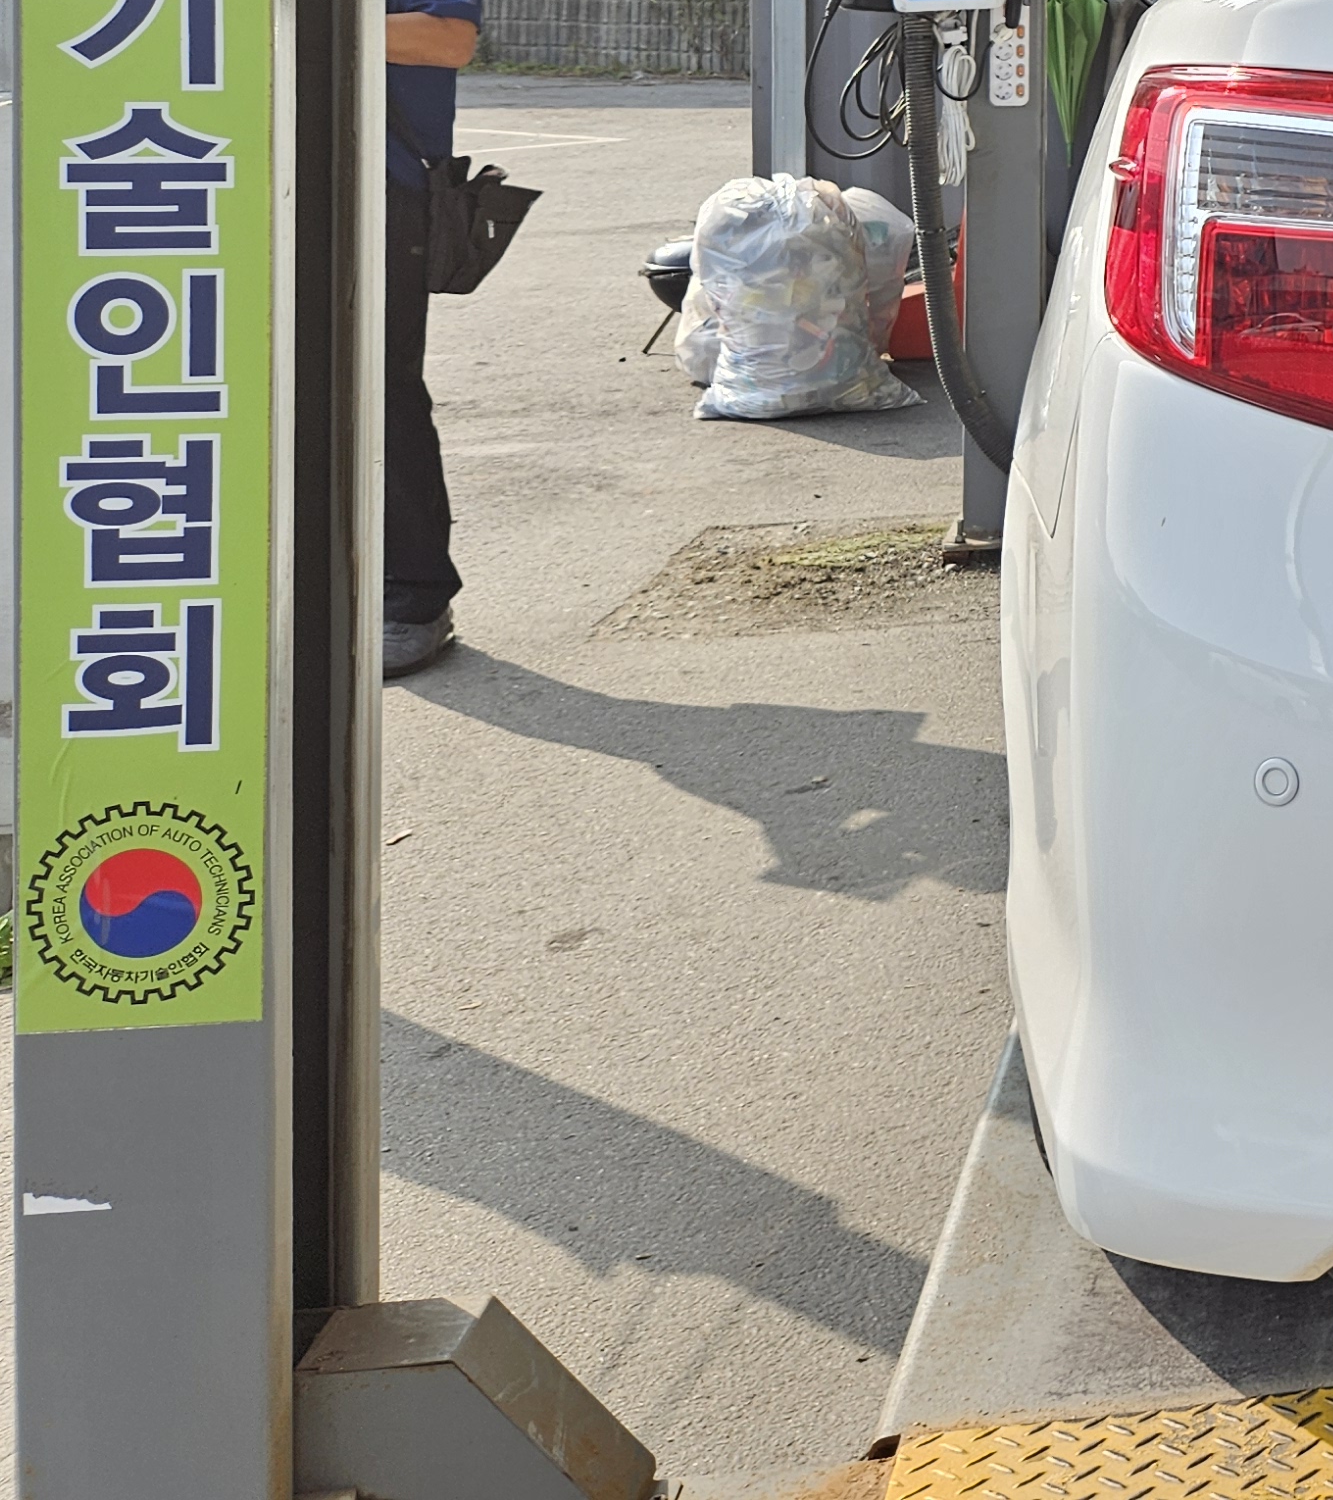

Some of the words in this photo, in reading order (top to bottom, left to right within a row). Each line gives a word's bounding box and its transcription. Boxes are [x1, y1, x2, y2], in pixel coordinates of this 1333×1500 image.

[137, 824, 160, 836] OF
[161, 827, 202, 852] AUTO
[56, 825, 133, 893] ASSOCIATION
[200, 848, 230, 936] TECHNICIANS
[53, 896, 74, 944] KOREA
[69, 942, 210, 983] 한국자동차기술인협회
